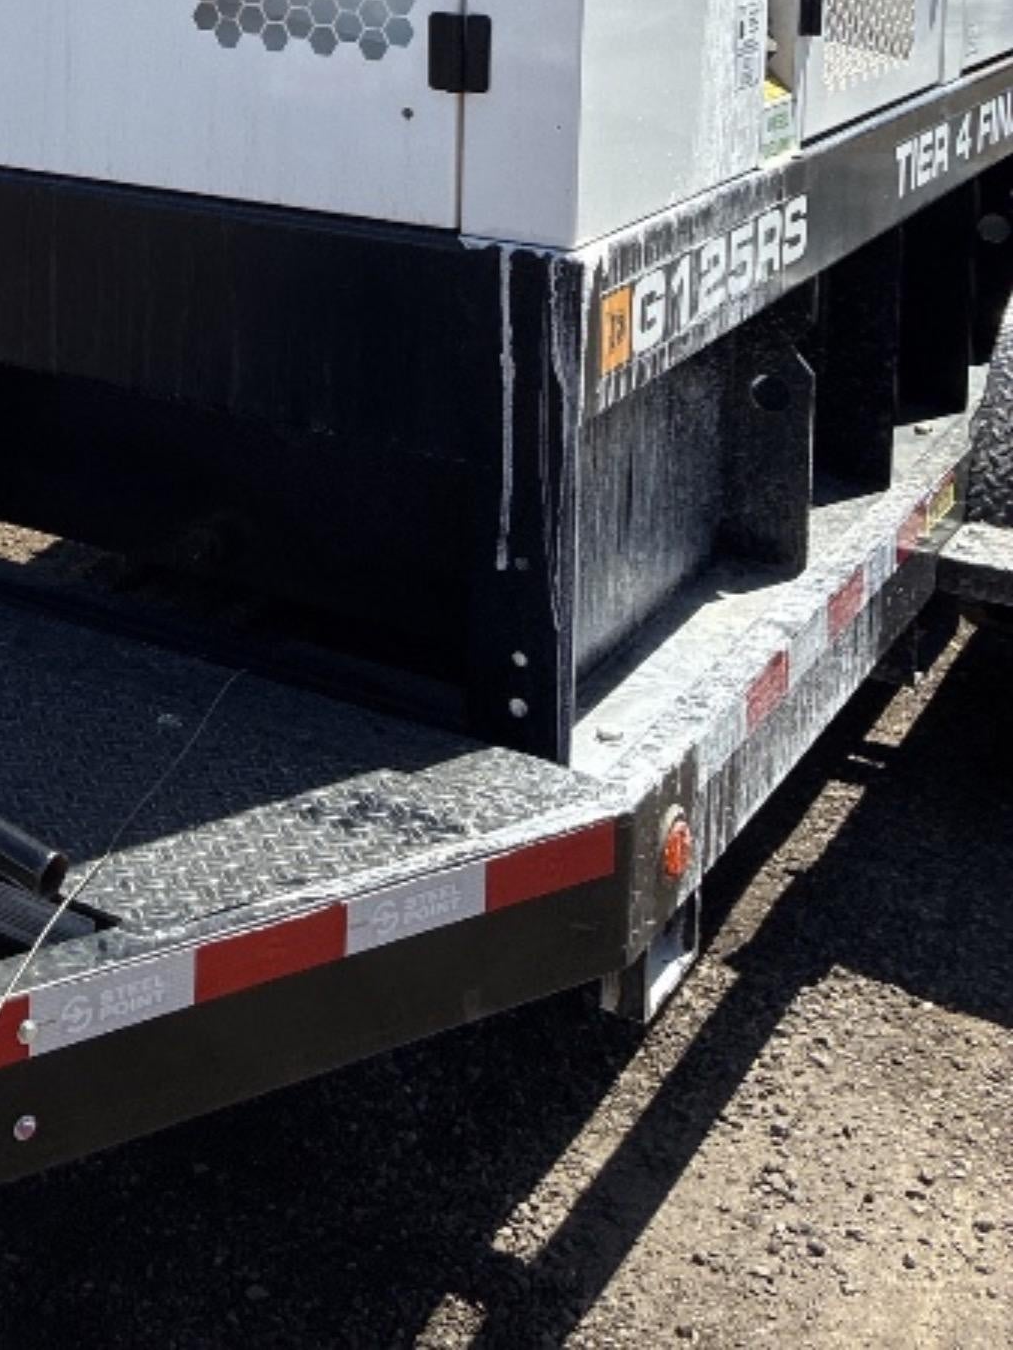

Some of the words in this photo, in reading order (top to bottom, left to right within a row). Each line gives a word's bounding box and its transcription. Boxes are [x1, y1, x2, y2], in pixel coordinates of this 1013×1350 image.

[895, 122, 950, 199] TIER
[956, 110, 972, 160] 4
[977, 90, 1013, 154] FIN
[632, 194, 808, 353] G125RS
[402, 896, 463, 926] POINT
[99, 974, 165, 1003] STEEL
[99, 988, 165, 1022] POINT
